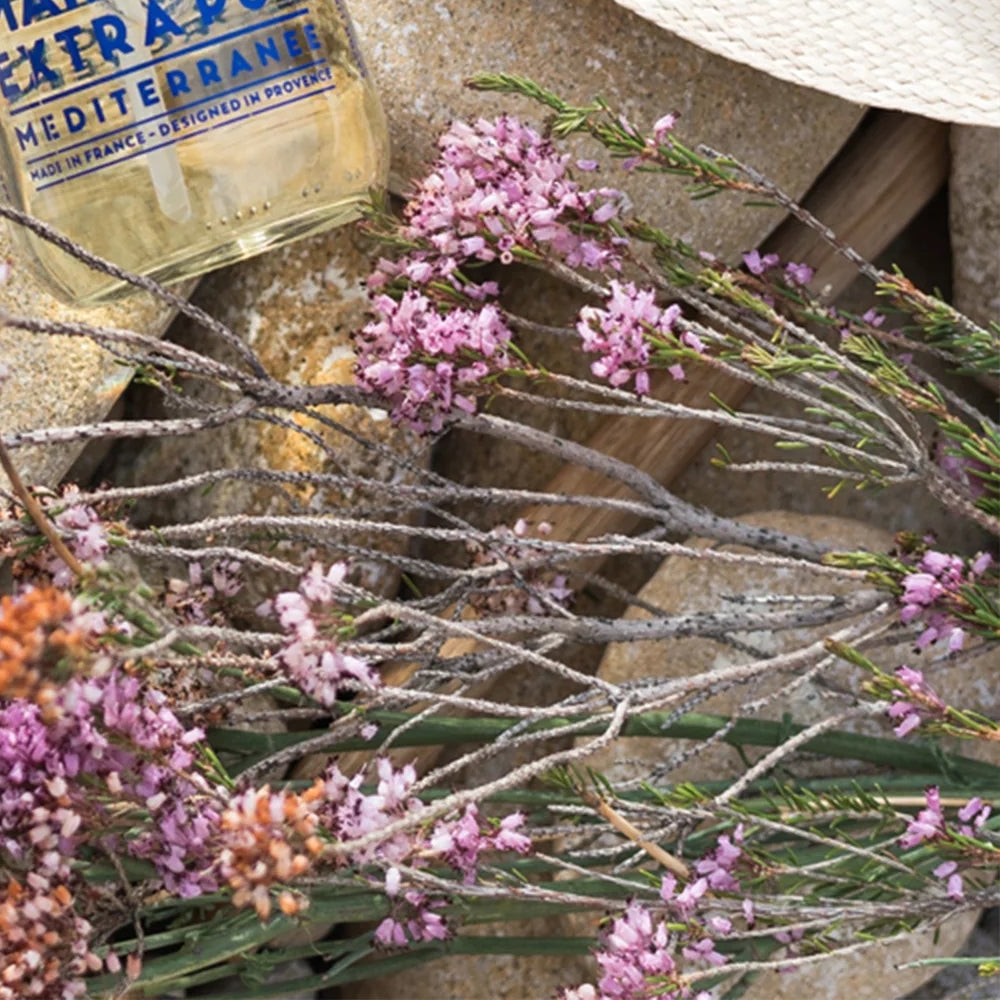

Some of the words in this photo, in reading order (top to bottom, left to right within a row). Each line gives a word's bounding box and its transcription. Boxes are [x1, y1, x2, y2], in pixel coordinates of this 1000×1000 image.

[14, 23, 322, 151] MEDITERRANEE
[29, 161, 64, 182] MADE
[66, 154, 83, 169] IN
[85, 131, 147, 163] FRANCE
[158, 101, 242, 137] DESIGNED
[244, 92, 261, 107] IN
[264, 67, 333, 99] PROVENCE
